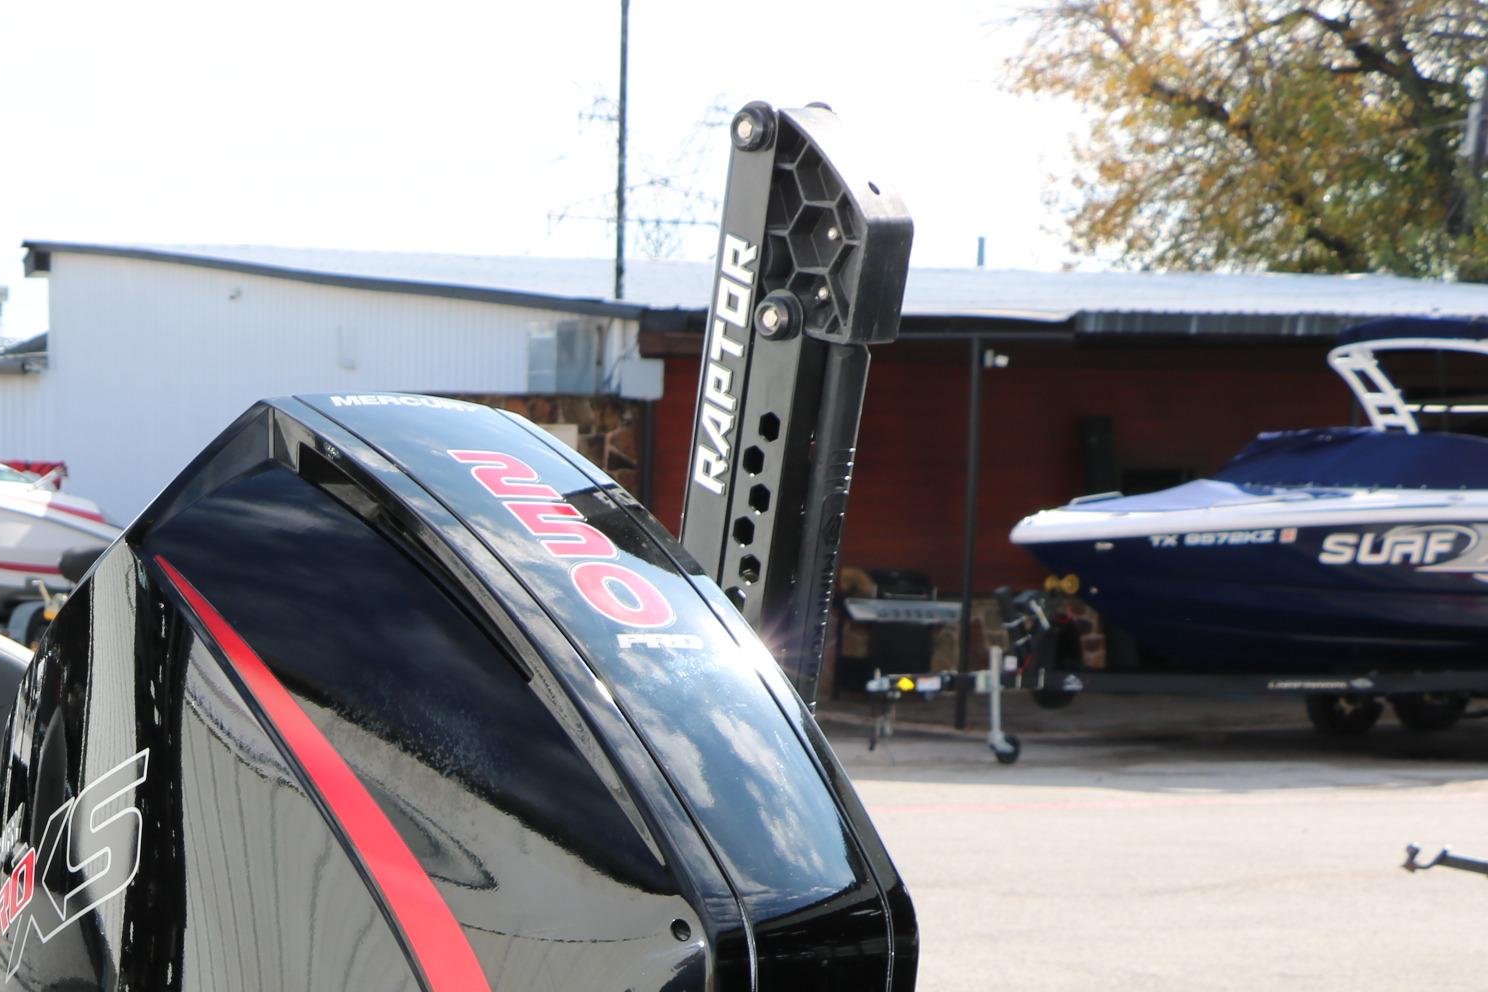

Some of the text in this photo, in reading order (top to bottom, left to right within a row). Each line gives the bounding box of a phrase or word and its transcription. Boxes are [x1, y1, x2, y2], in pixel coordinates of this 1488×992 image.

[330, 395, 481, 412] MERCURY
[694, 232, 758, 496] RAPTOR
[446, 449, 676, 628] 250
